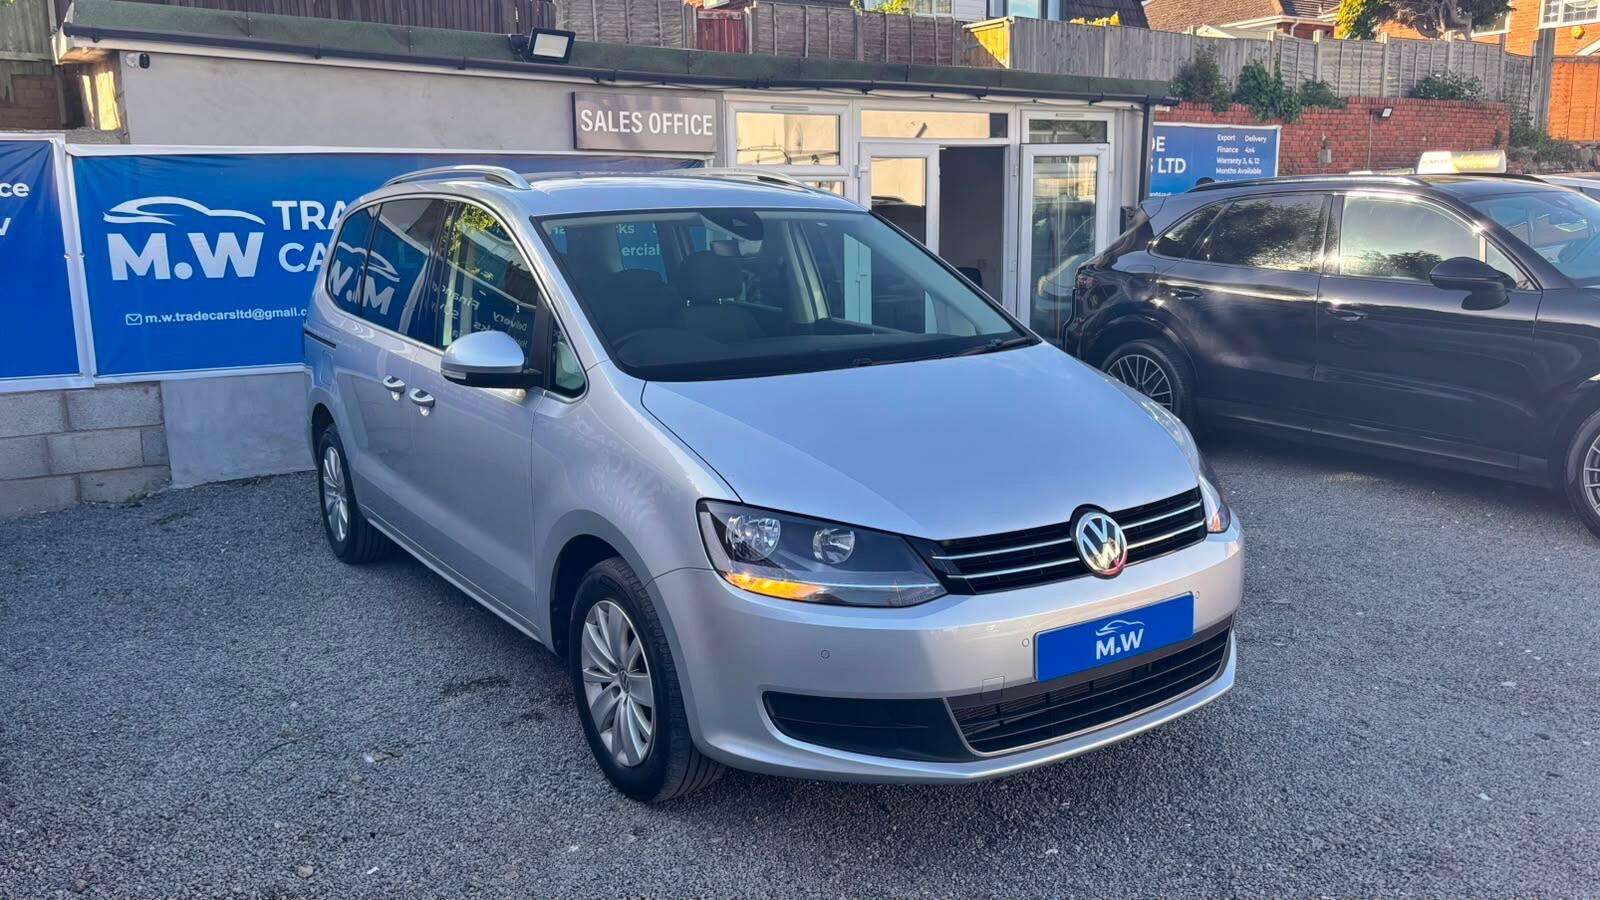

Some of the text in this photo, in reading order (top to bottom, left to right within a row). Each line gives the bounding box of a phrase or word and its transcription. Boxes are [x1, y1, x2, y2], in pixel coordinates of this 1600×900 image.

[580, 109, 713, 136] SALES OFFICE
[1217, 133, 1236, 142] Export
[1244, 134, 1267, 143] Delivery
[1217, 145, 1239, 153] Finance
[1158, 157, 1187, 174] LTD
[1216, 157, 1241, 165] Warranty
[1216, 167, 1262, 175] Months Available
[106, 232, 264, 281] M.W
[1096, 628, 1144, 661] M.W
